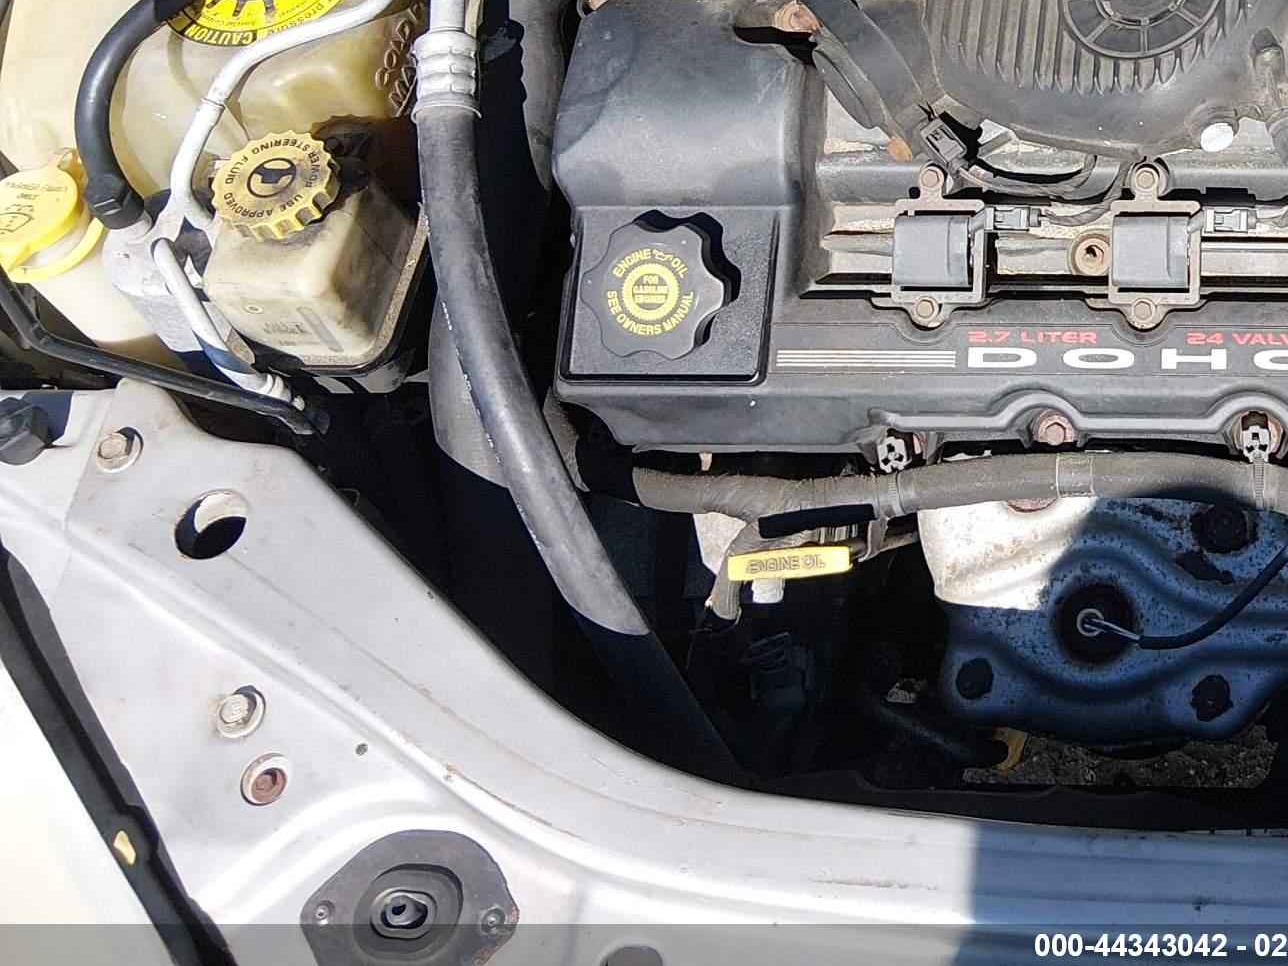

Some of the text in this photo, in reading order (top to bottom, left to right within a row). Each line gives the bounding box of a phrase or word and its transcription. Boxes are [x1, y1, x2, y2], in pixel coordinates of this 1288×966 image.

[185, 23, 255, 46] CAUTION
[225, 138, 321, 188] POWER STEERING FLUID
[223, 192, 304, 218] USE APPROVED
[612, 248, 689, 279] ENGINE OIL
[632, 285, 669, 294] GASOLINE
[643, 275, 659, 284] FOR
[634, 295, 667, 304] ENGINES
[606, 290, 694, 335] SEE OWNERS MANUAL
[967, 330, 1008, 344] 2.7
[1019, 330, 1098, 344] LITER
[1187, 332, 1223, 345] 24
[746, 554, 826, 574] ENGINE OIL
